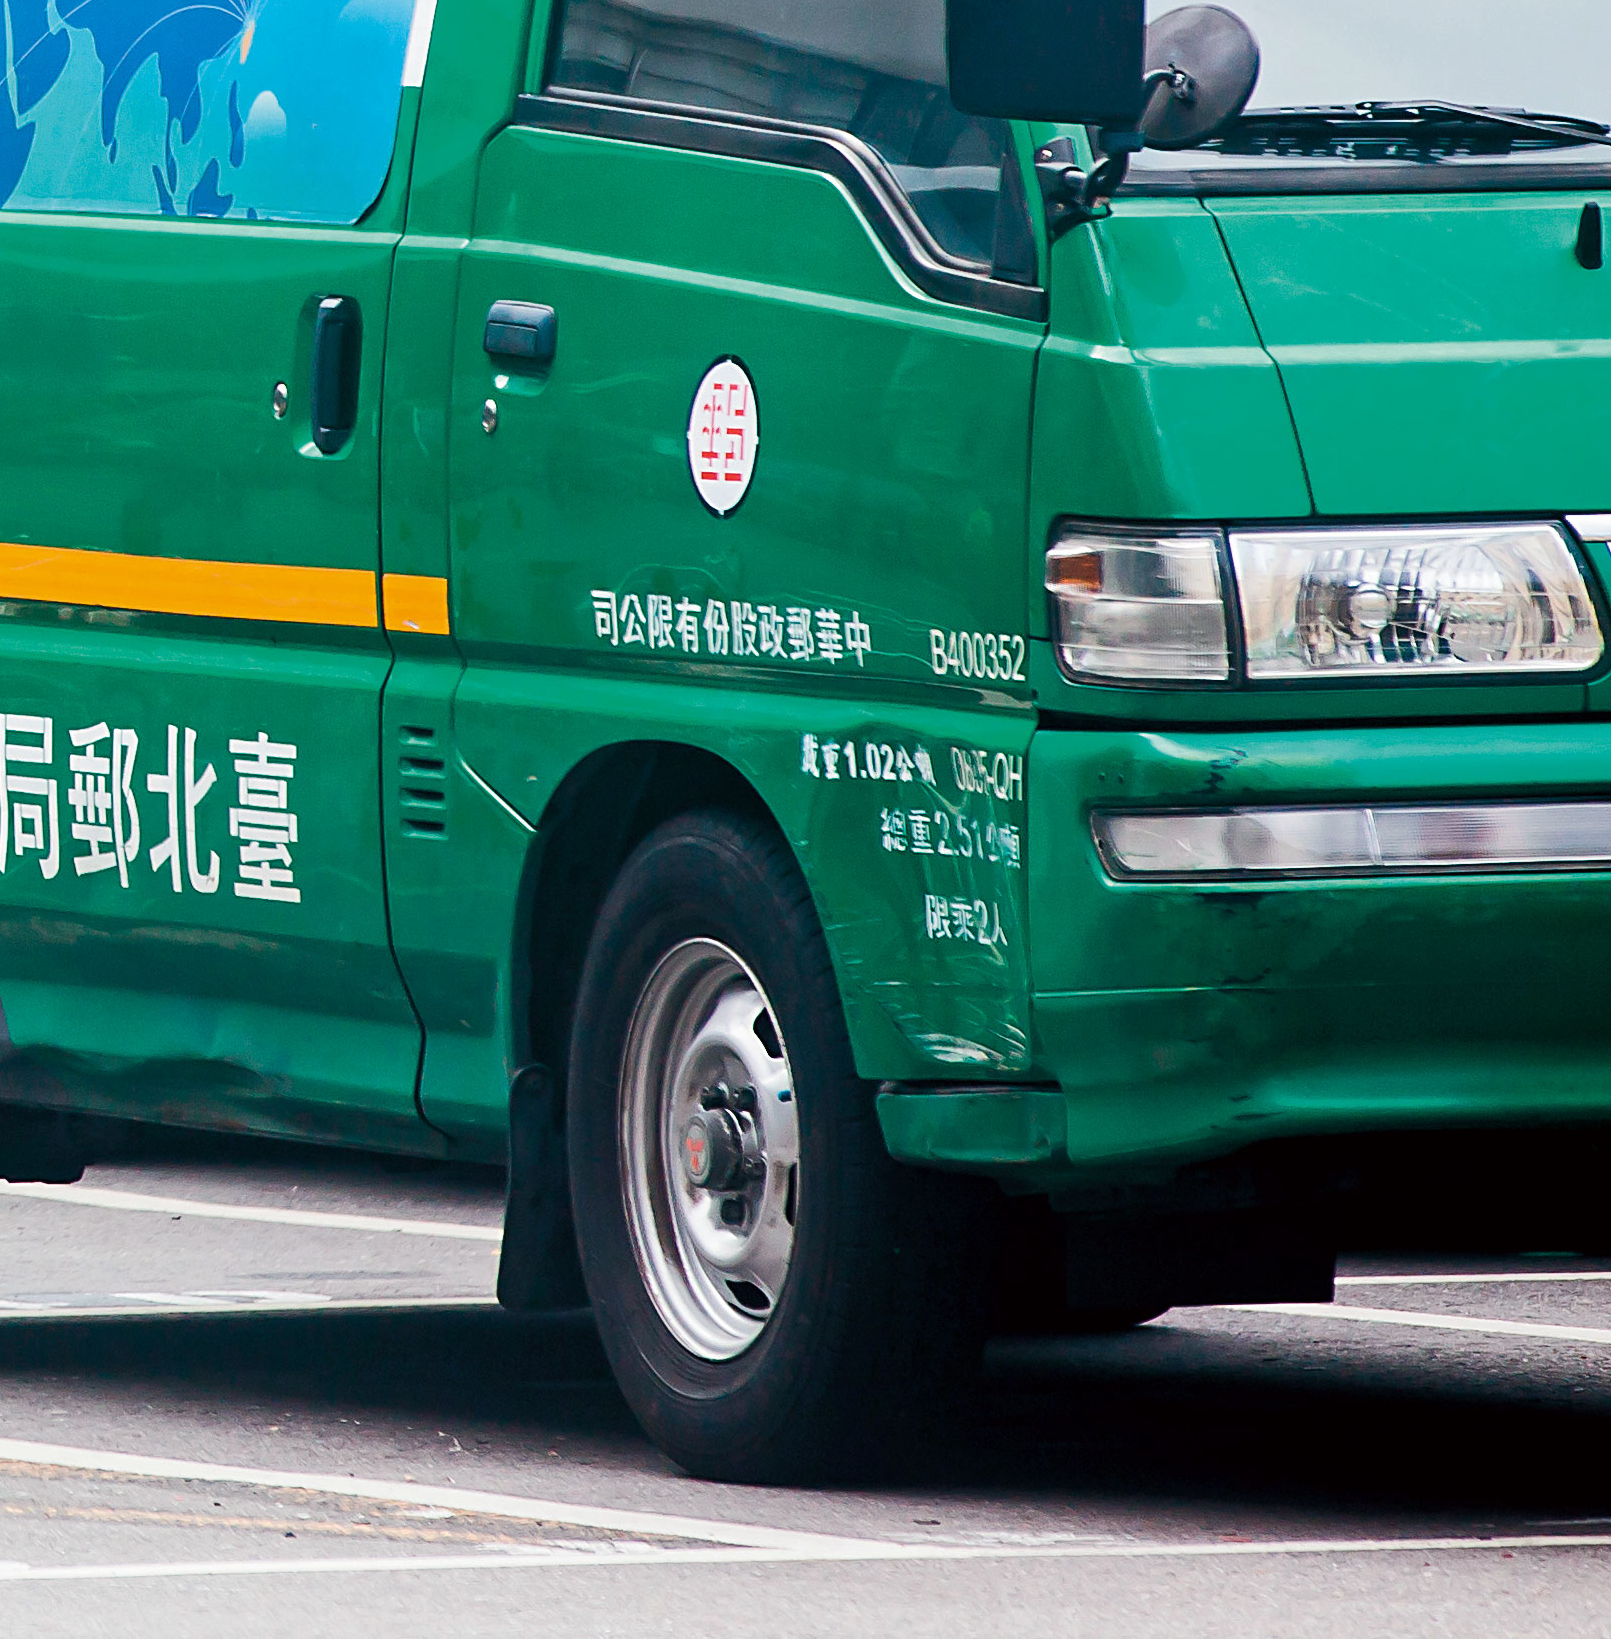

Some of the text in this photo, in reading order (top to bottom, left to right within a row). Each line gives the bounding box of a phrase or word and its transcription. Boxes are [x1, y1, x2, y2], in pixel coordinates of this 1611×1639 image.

[929, 628, 1026, 682] B400352
[924, 894, 1008, 947] 限乘2人
